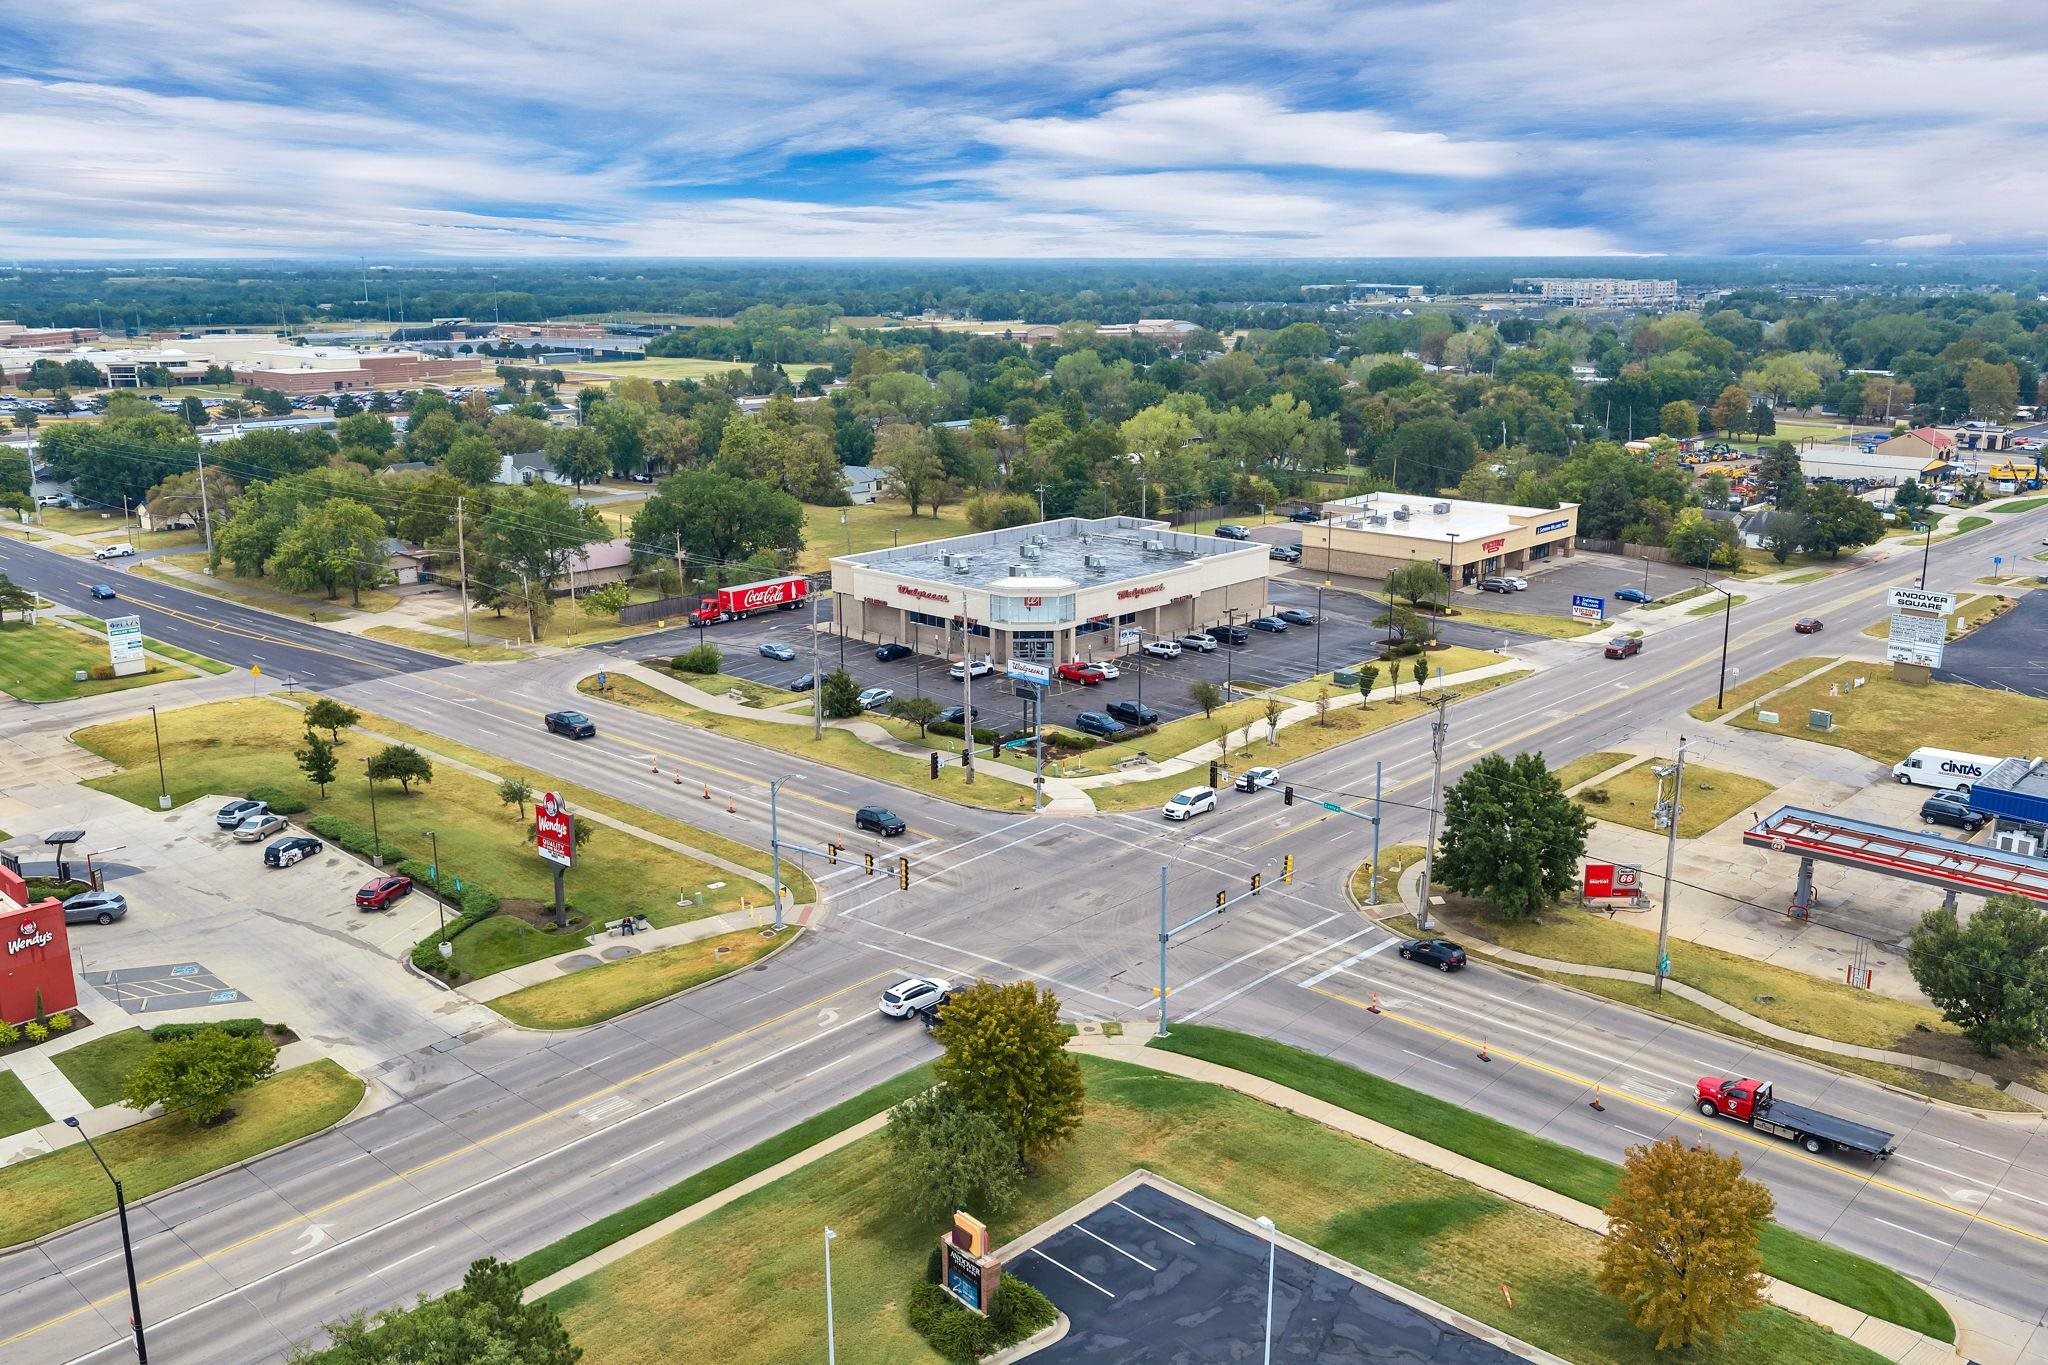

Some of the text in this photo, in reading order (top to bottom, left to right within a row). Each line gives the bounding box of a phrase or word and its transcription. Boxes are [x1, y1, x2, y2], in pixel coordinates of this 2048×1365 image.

[744, 583, 784, 607] Coca-Cola
[897, 584, 950, 602] Walgreens
[1116, 583, 1166, 600] Walgreens
[1895, 591, 1948, 603] ANDOVER
[1573, 607, 1600, 616] VICTORY
[1897, 598, 1942, 611] SQUARE
[1012, 661, 1045, 676] Walgreens
[538, 815, 567, 838] Wendy's
[1620, 875, 1634, 883] 66
[7, 930, 53, 955] Wendy's
